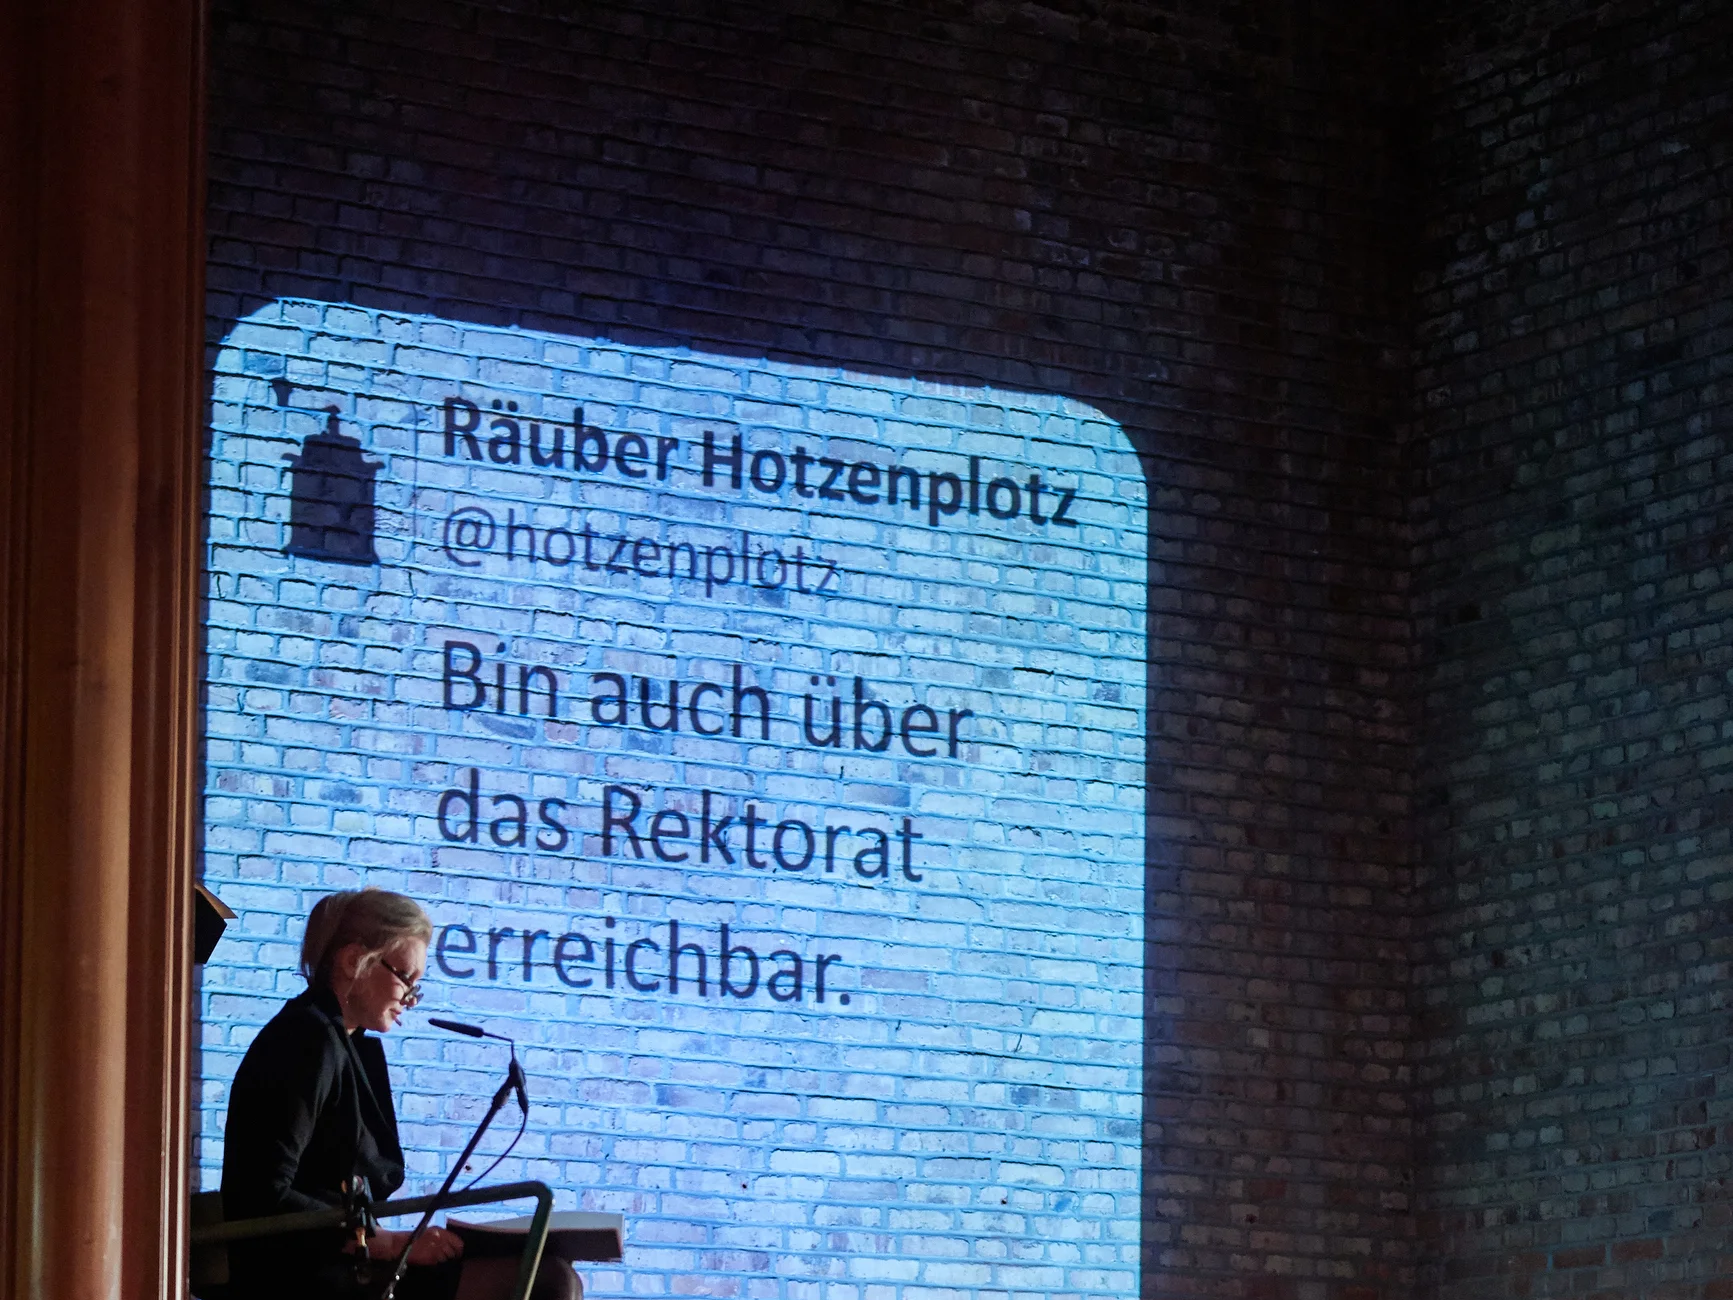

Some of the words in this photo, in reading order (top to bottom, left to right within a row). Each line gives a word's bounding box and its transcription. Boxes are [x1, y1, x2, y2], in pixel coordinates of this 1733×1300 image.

[443, 396, 679, 482] Räuber
[702, 430, 1079, 528] Hotzenplotz
[443, 505, 839, 597] @hotzenplotz
[443, 639, 558, 717] Bin
[591, 666, 770, 740] auch
[804, 676, 975, 759] über
[437, 768, 569, 852] das
[602, 785, 923, 883] Rektorat
[436, 917, 852, 1006] erreichbar.
